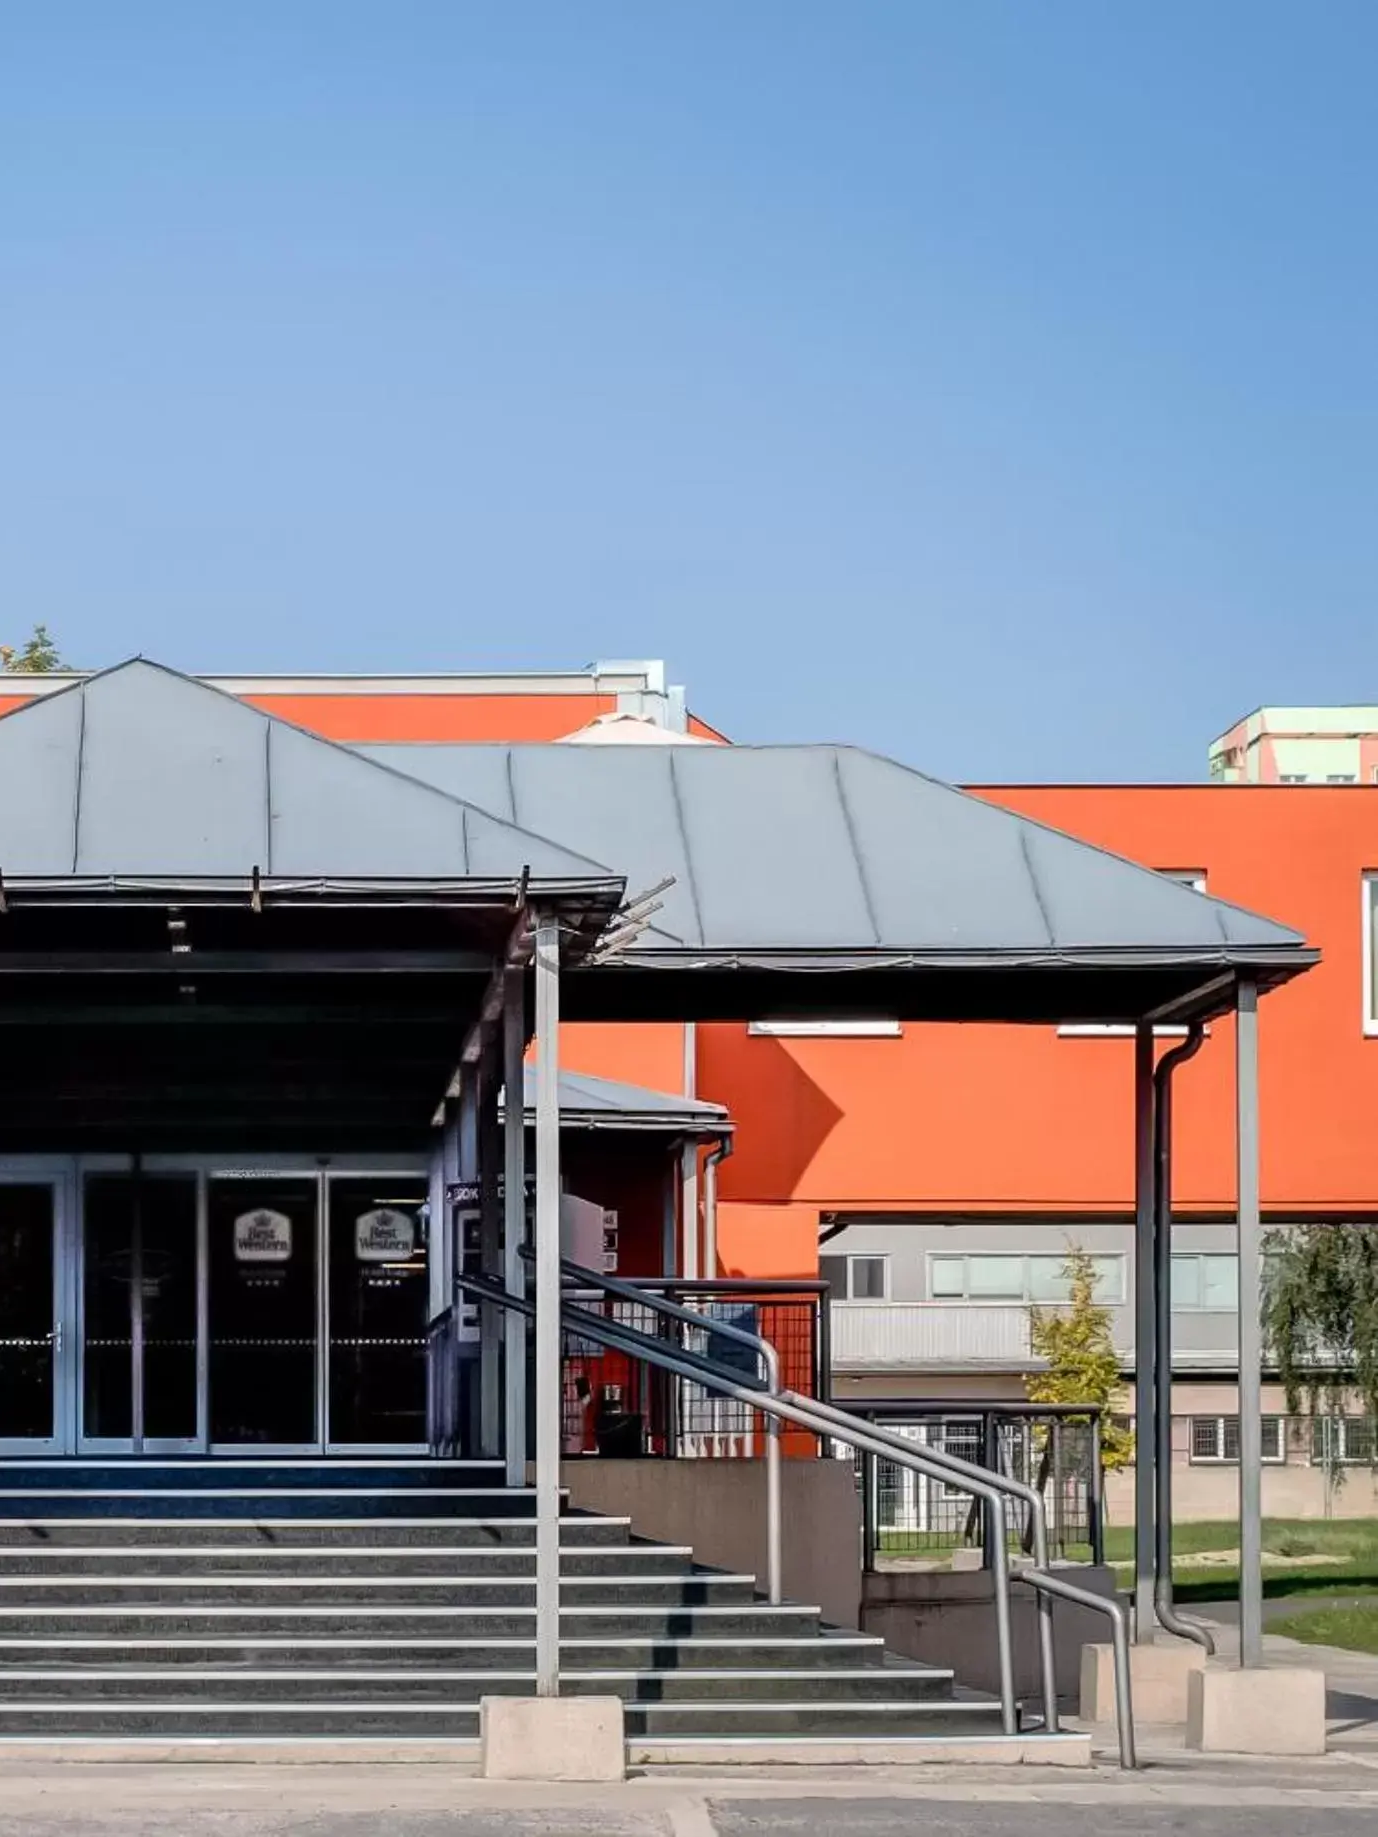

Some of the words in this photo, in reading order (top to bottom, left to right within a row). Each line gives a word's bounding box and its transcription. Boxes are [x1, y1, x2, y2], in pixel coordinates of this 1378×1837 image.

[248, 1226, 276, 1240] Best
[370, 1226, 397, 1239] Best
[238, 1239, 288, 1251] Western
[359, 1239, 410, 1251] Western
